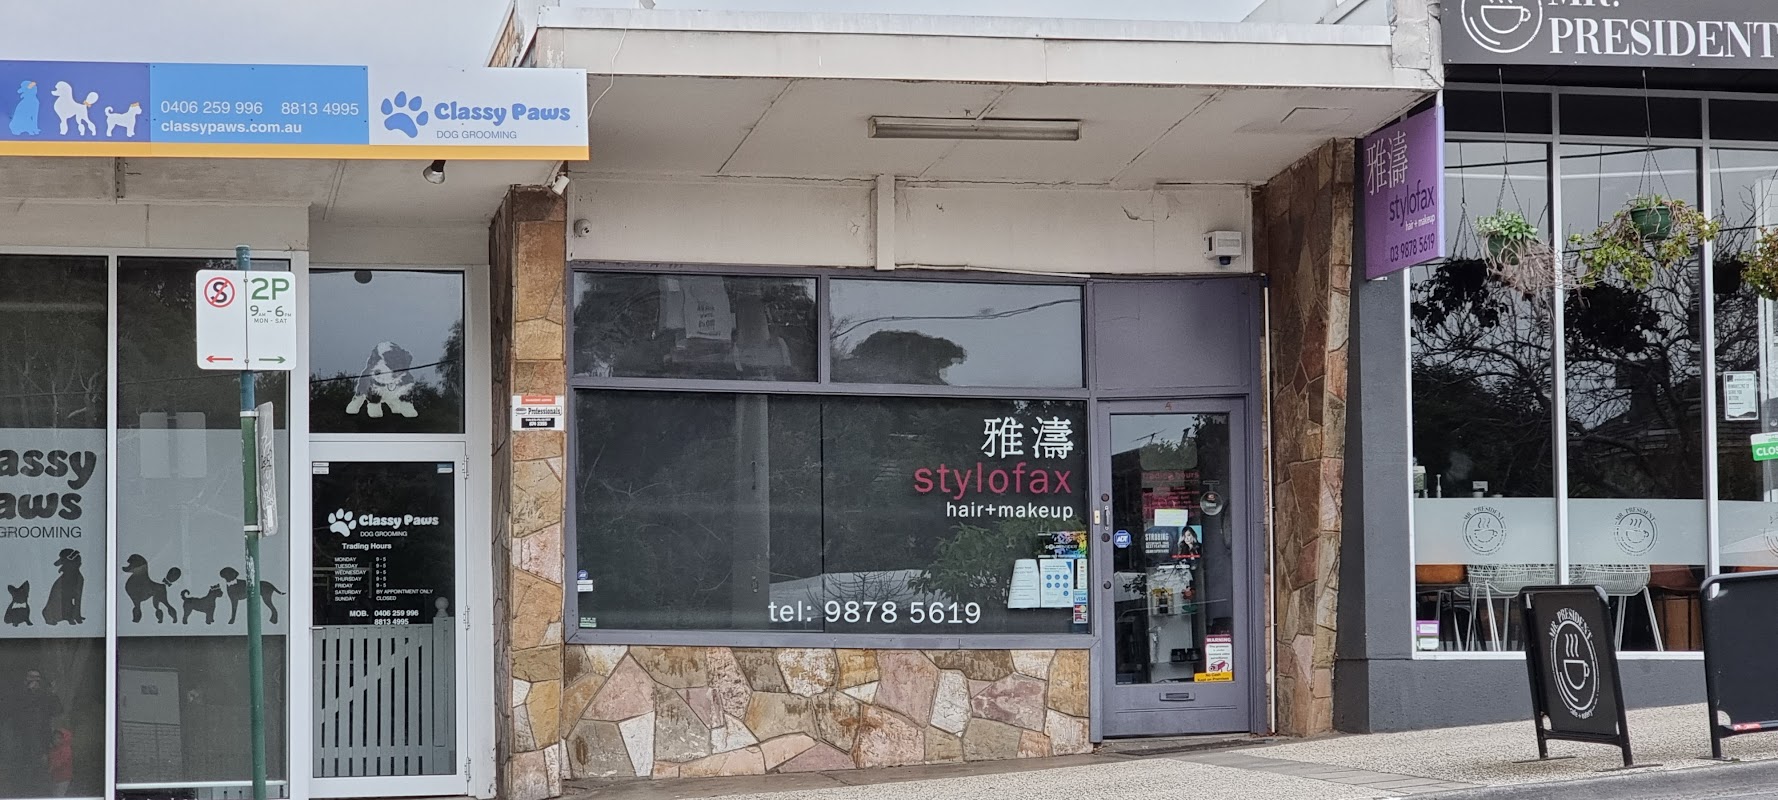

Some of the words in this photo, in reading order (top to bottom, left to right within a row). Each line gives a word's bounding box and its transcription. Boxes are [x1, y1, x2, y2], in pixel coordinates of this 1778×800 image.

[1549, 17, 1778, 58] PRESIDENT
[161, 100, 198, 114] 0406
[202, 101, 231, 114] 259
[235, 102, 263, 115] 996
[281, 102, 318, 115] 8813
[322, 102, 359, 115] 4995
[434, 101, 507, 126] Classy
[511, 103, 570, 121] Paws
[161, 120, 302, 134] classypaws.com.au
[436, 130, 459, 139] DOG
[462, 130, 517, 139] GROOMING
[1366, 130, 1408, 196] 雅濤
[1389, 179, 1435, 227] stylofax
[1390, 245, 1399, 263] 03
[1400, 238, 1417, 260] 9878
[1419, 232, 1435, 253] 5619
[250, 277, 290, 300] 2P
[528, 407, 560, 415] Professionals
[981, 416, 1074, 460] 雅濤
[914, 461, 1072, 500] stylofax
[358, 513, 402, 529] Classy
[404, 514, 439, 526] Paws
[946, 501, 1073, 521] hair+makeup
[342, 543, 369, 551] Trading
[768, 600, 812, 622] tel:
[824, 601, 898, 624] 9878
[909, 602, 981, 624] 5619
[1556, 607, 1593, 640] PRESIDENT
